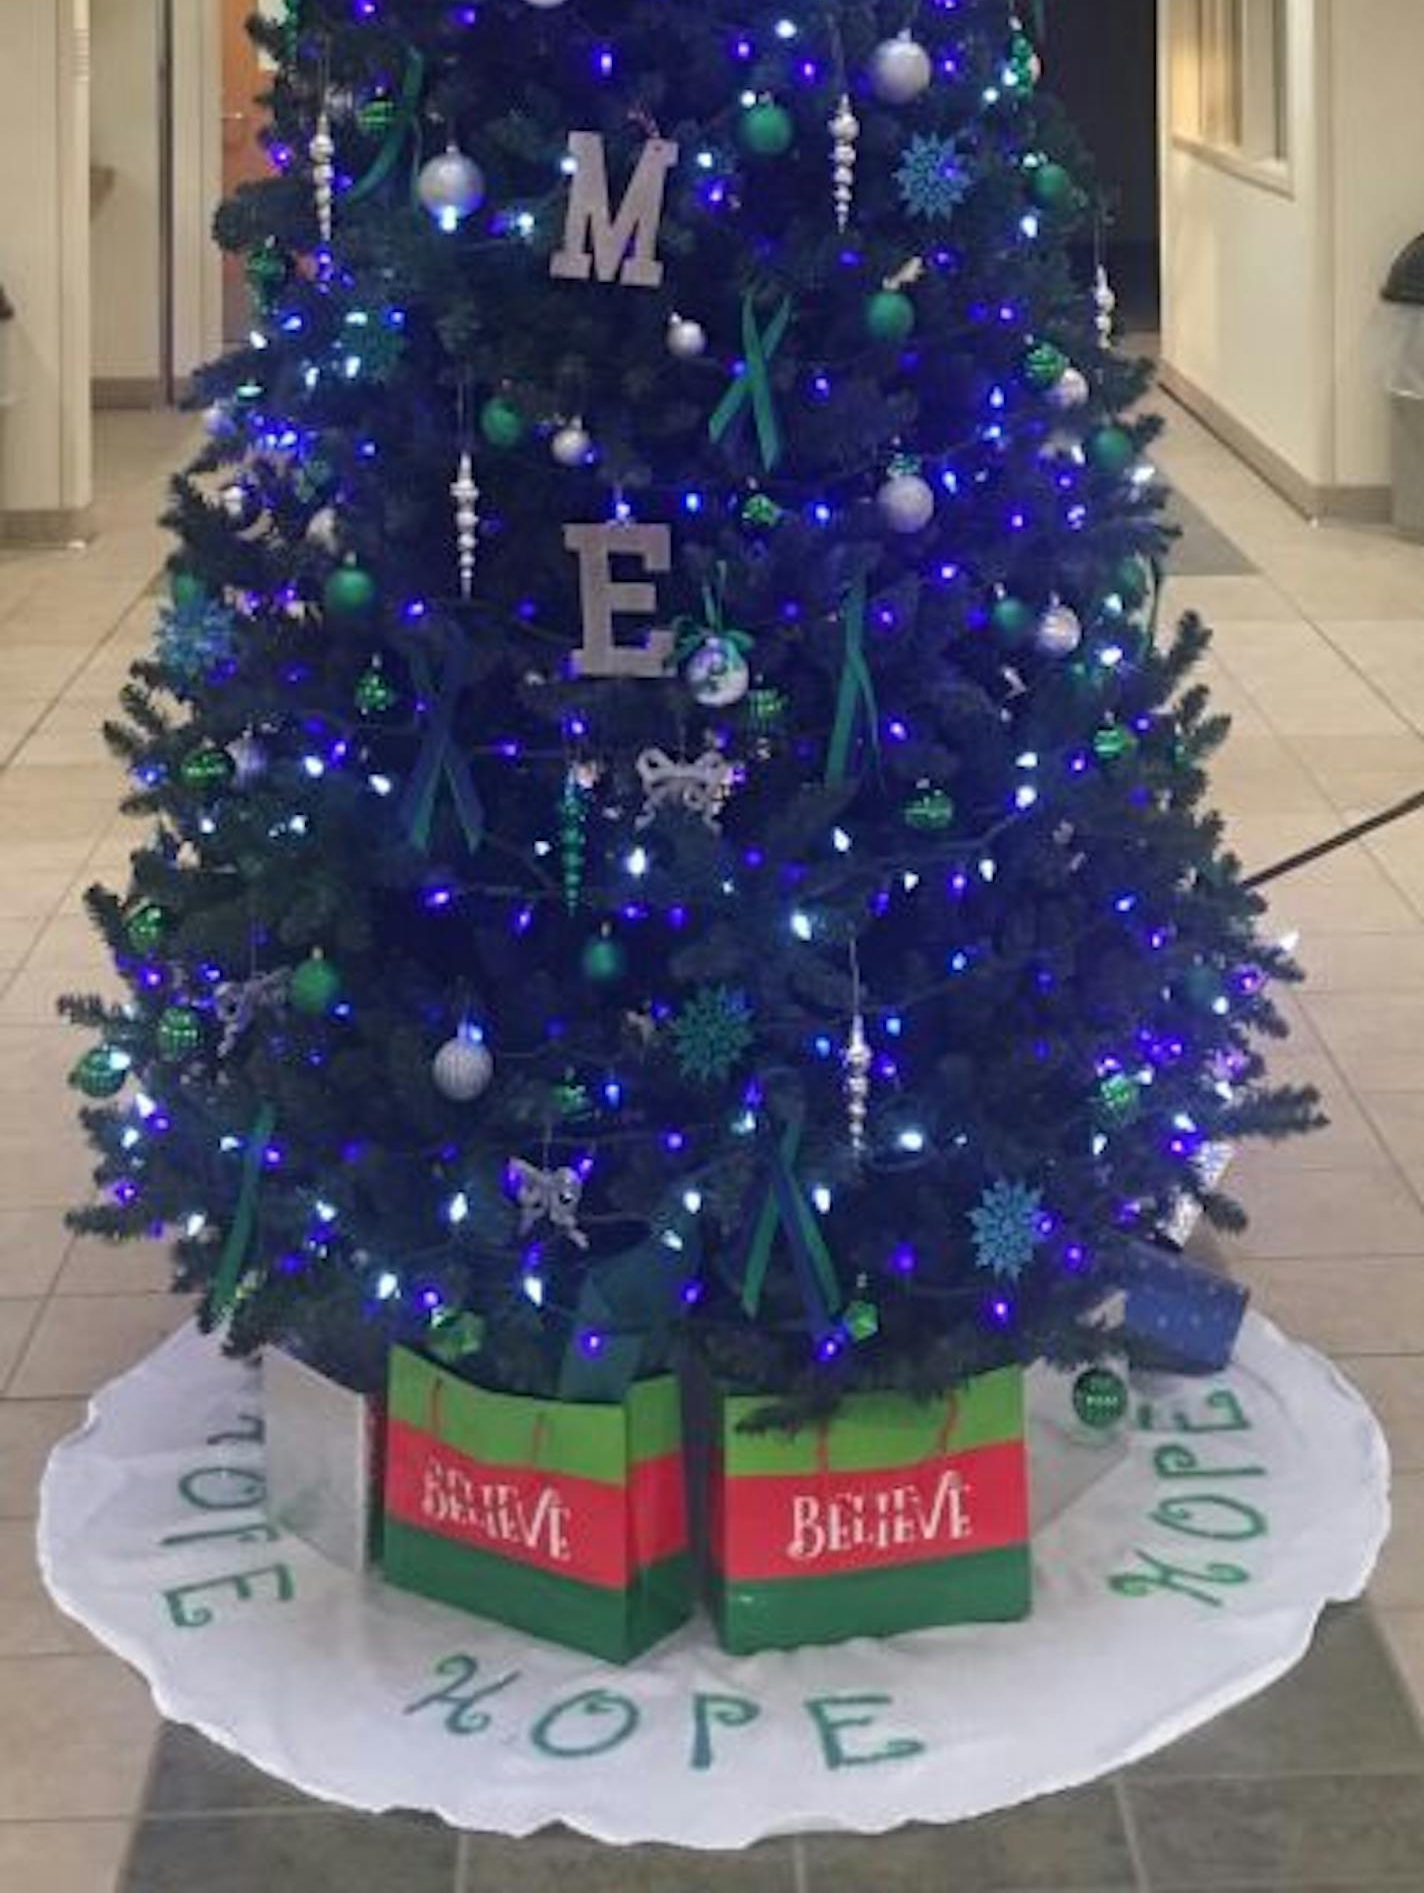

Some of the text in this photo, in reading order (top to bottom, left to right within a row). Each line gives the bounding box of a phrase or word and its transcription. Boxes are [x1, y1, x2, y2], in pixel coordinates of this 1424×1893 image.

[422, 1456, 571, 1561] BELIEVE
[787, 1469, 973, 1560] BELIEVE
[1108, 1390, 1267, 1607] HOPE
[404, 1653, 926, 1771] HOPE
